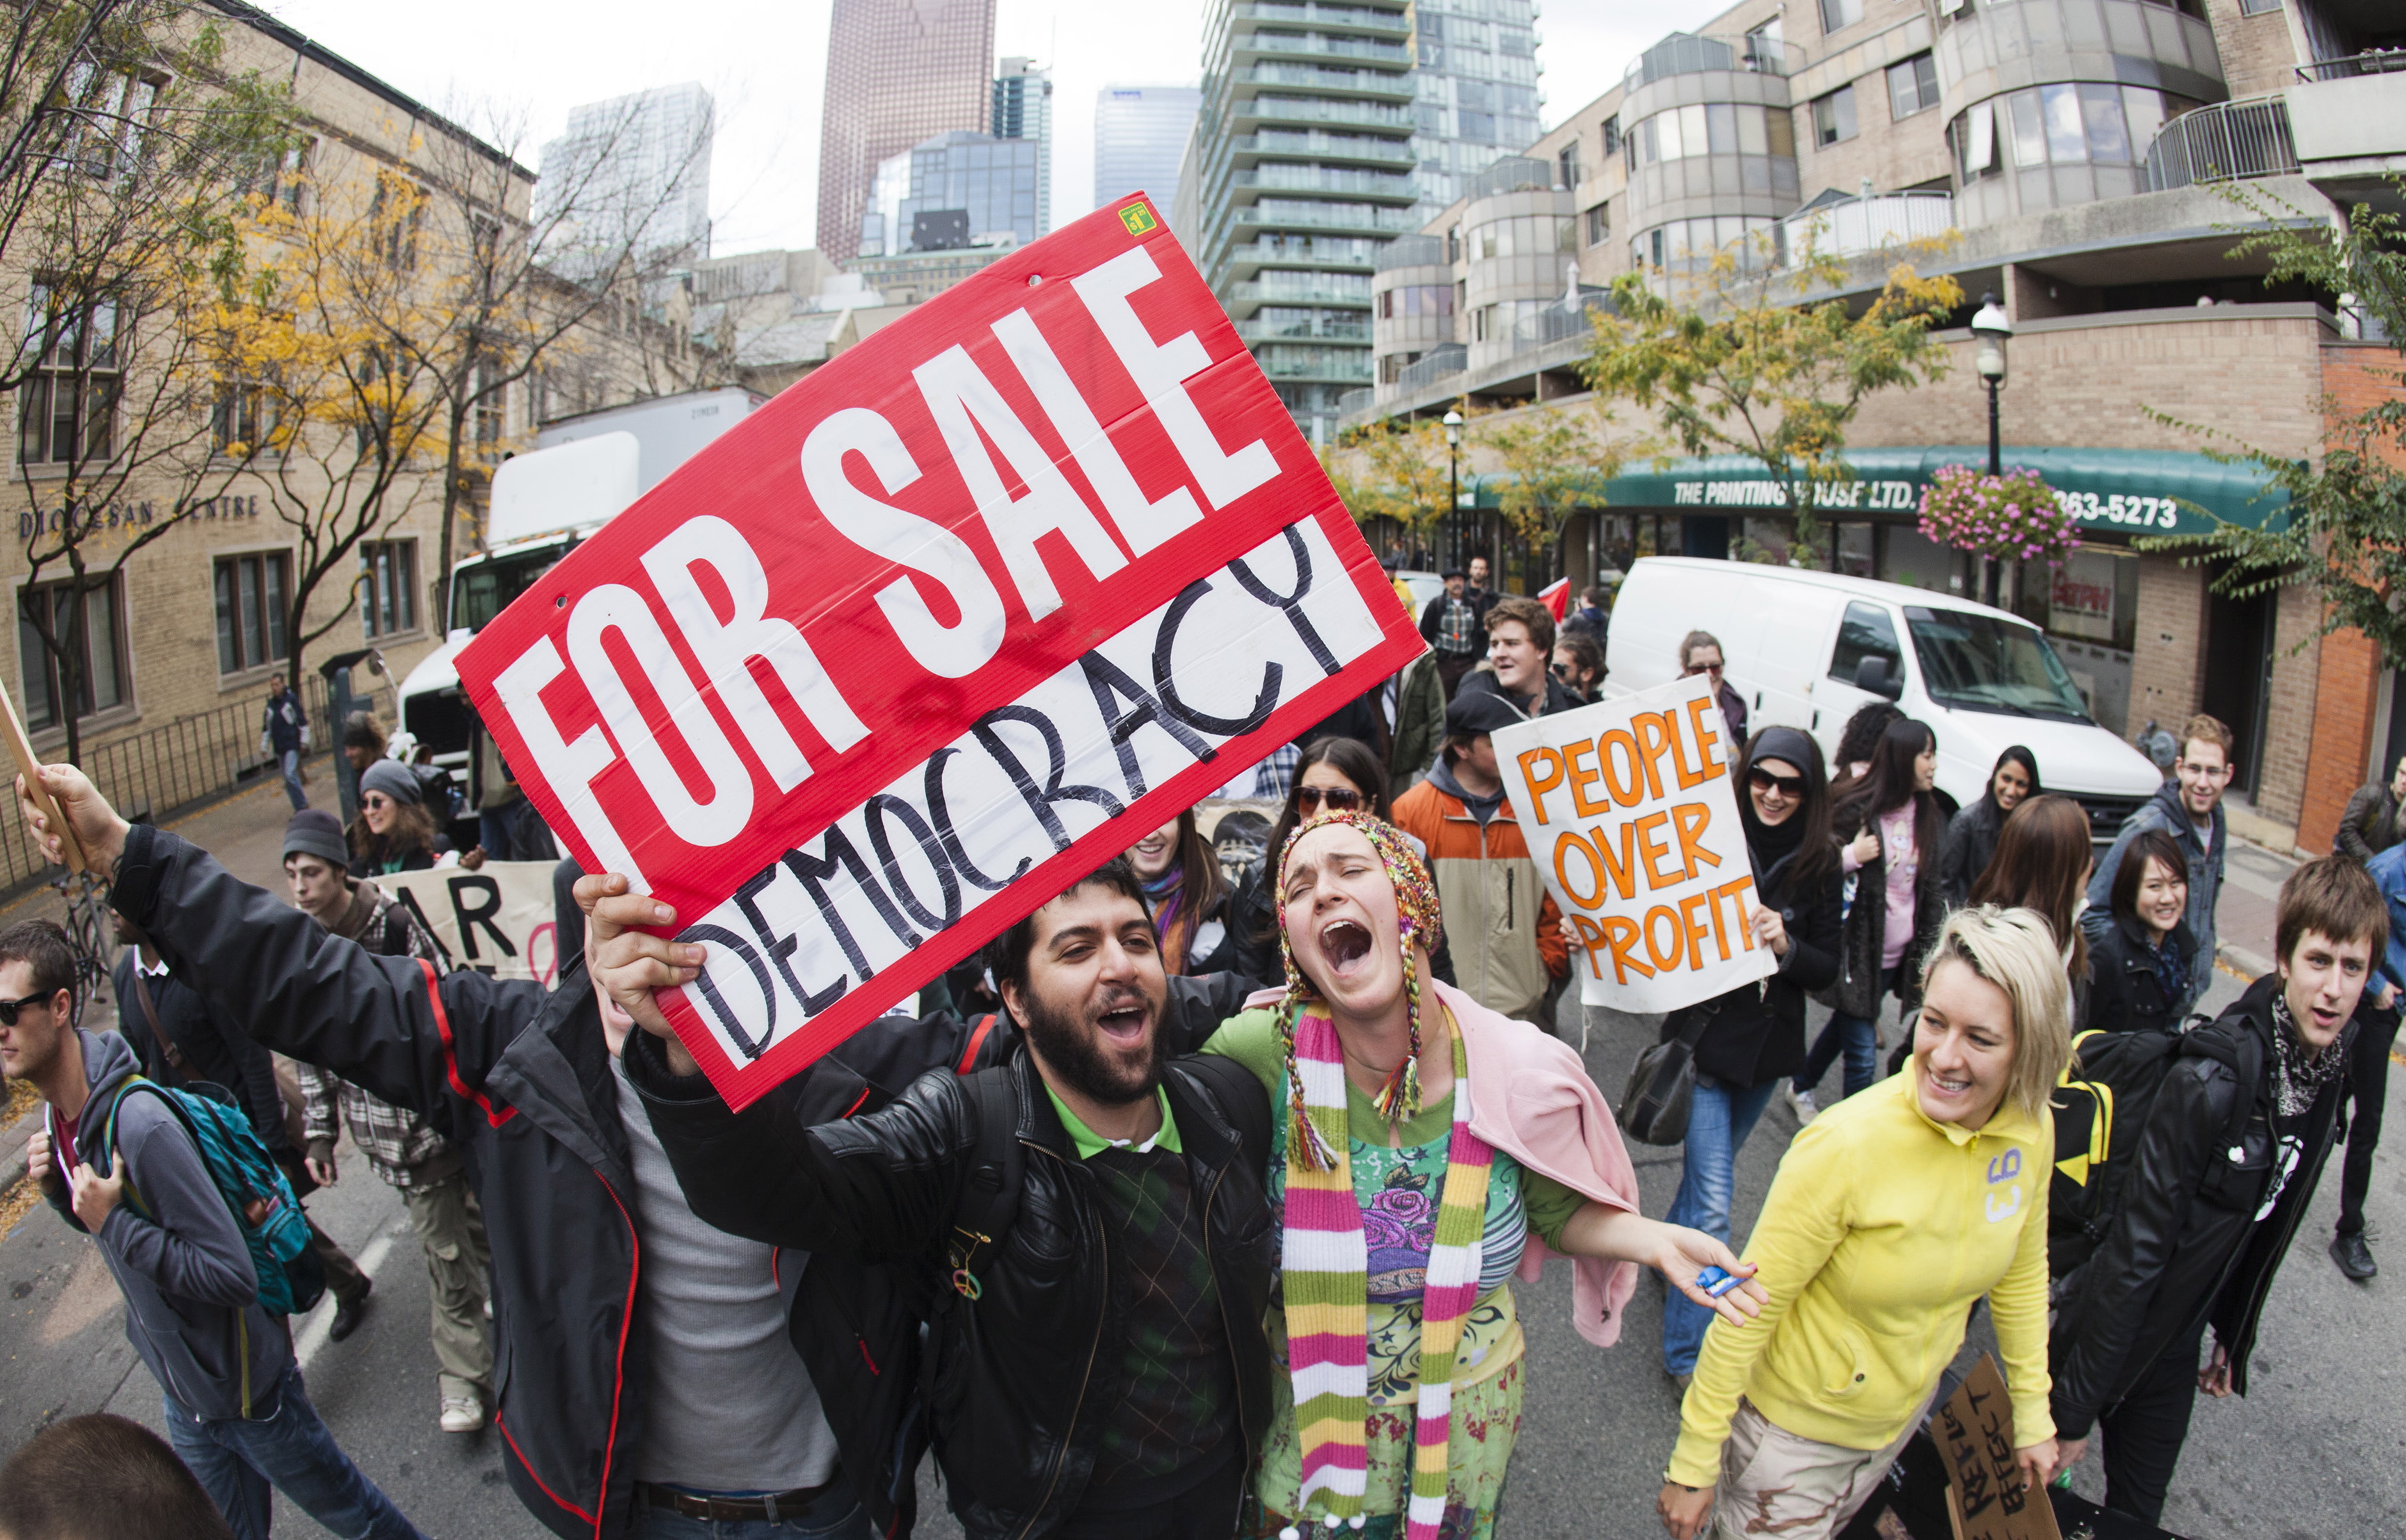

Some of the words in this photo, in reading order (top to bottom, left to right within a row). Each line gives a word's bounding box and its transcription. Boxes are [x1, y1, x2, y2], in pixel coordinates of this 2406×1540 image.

[19, 500, 152, 538] DIOCESAN
[1674, 481, 1704, 504] THE
[1705, 480, 1789, 506] PRINTING
[1868, 480, 1917, 510] LTD.
[491, 515, 873, 897] FOR
[800, 243, 1283, 680] SALE
[674, 522, 1344, 1060] DEMOCRACY
[1517, 696, 1726, 826] PEOPLE
[1553, 802, 1723, 911] OVER
[1570, 874, 1755, 986] PROFIT
